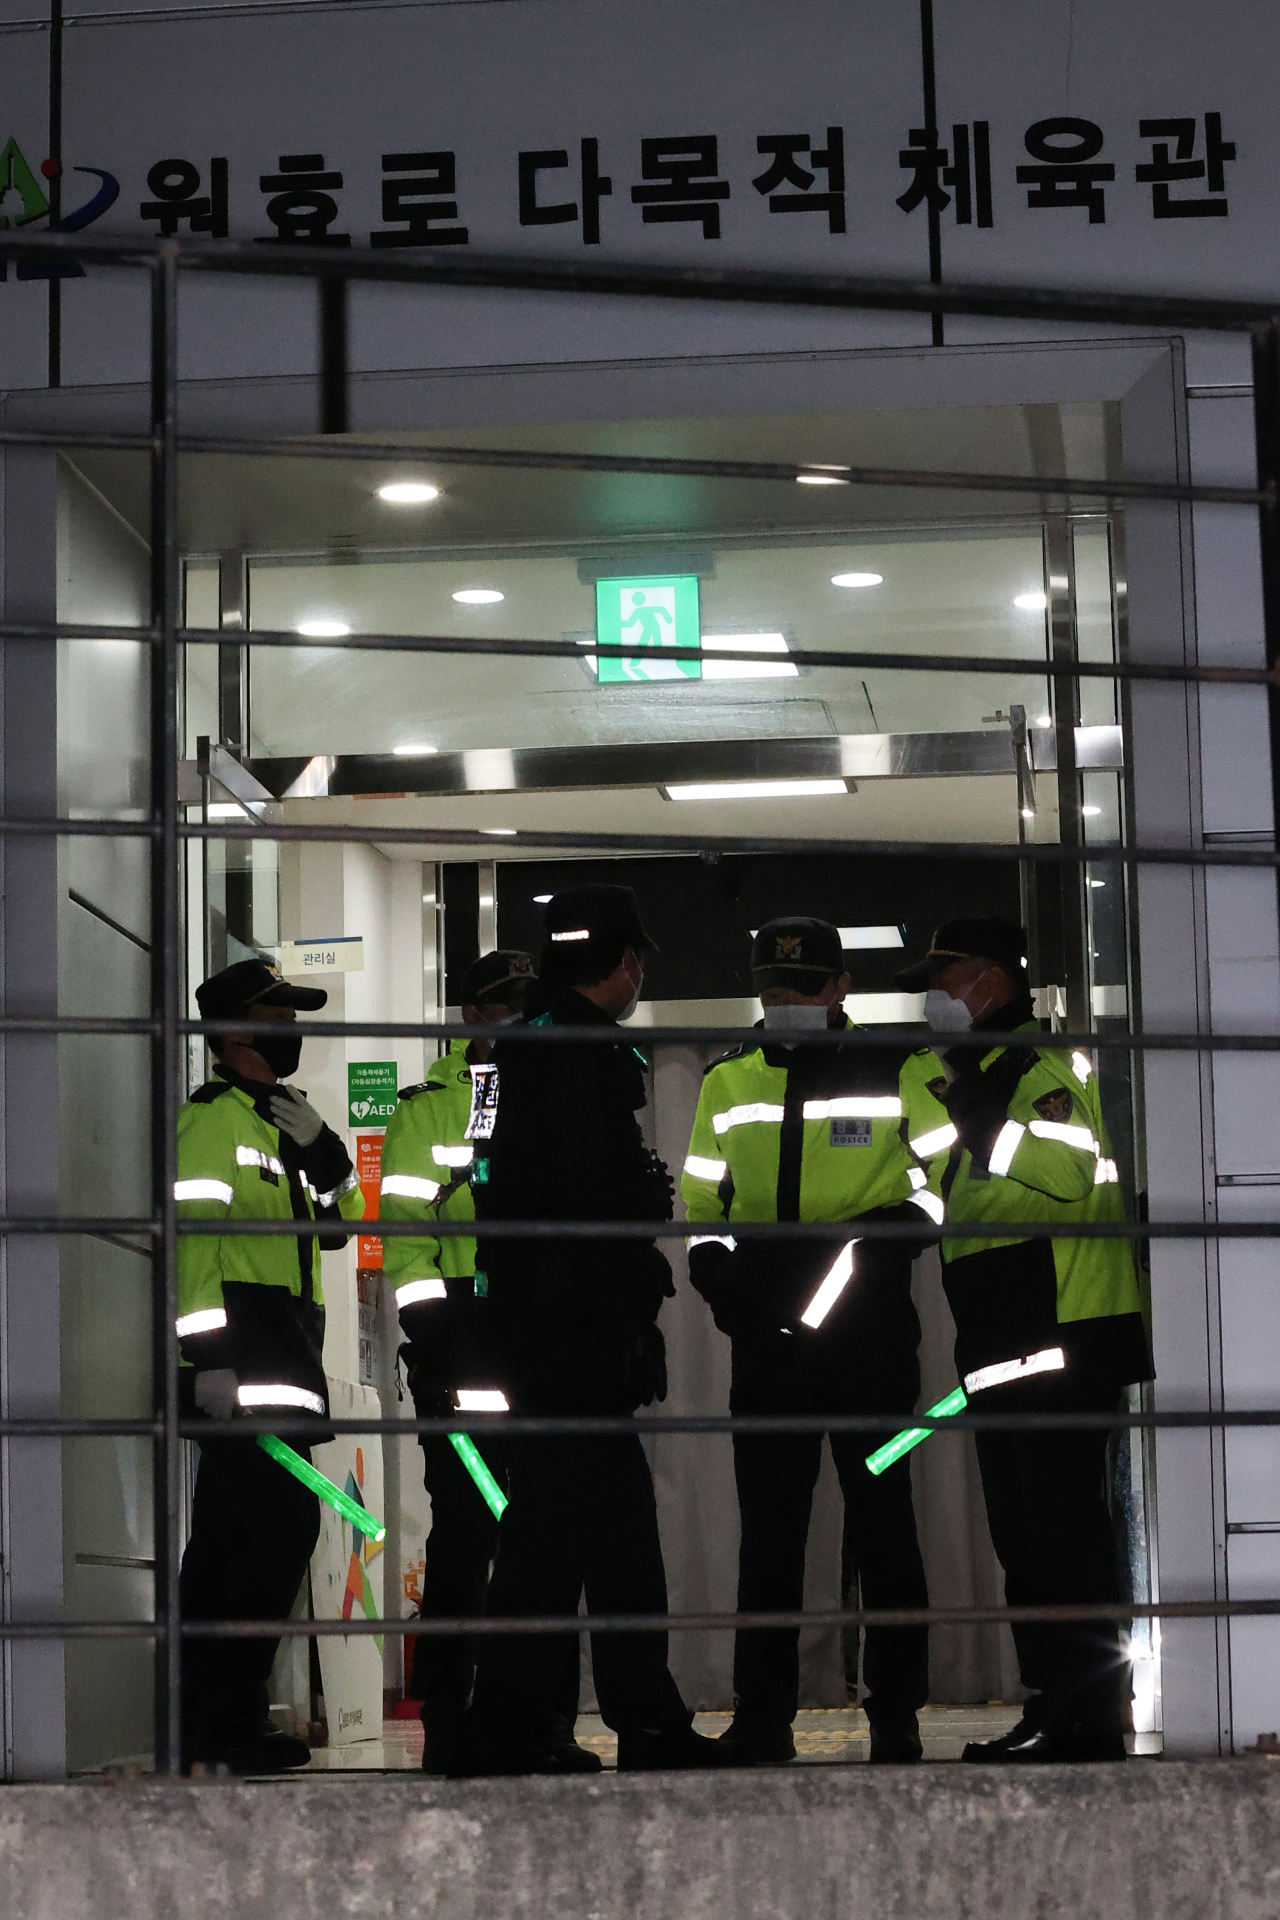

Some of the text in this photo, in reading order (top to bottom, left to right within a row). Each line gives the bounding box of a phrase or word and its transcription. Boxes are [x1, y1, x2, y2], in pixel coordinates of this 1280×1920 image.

[140, 112, 1236, 249] 원효로 다목적 체육관
[303, 951, 336, 966] 관리실
[369, 1104, 396, 1116] AED
[833, 1136, 869, 1144] POLICE
